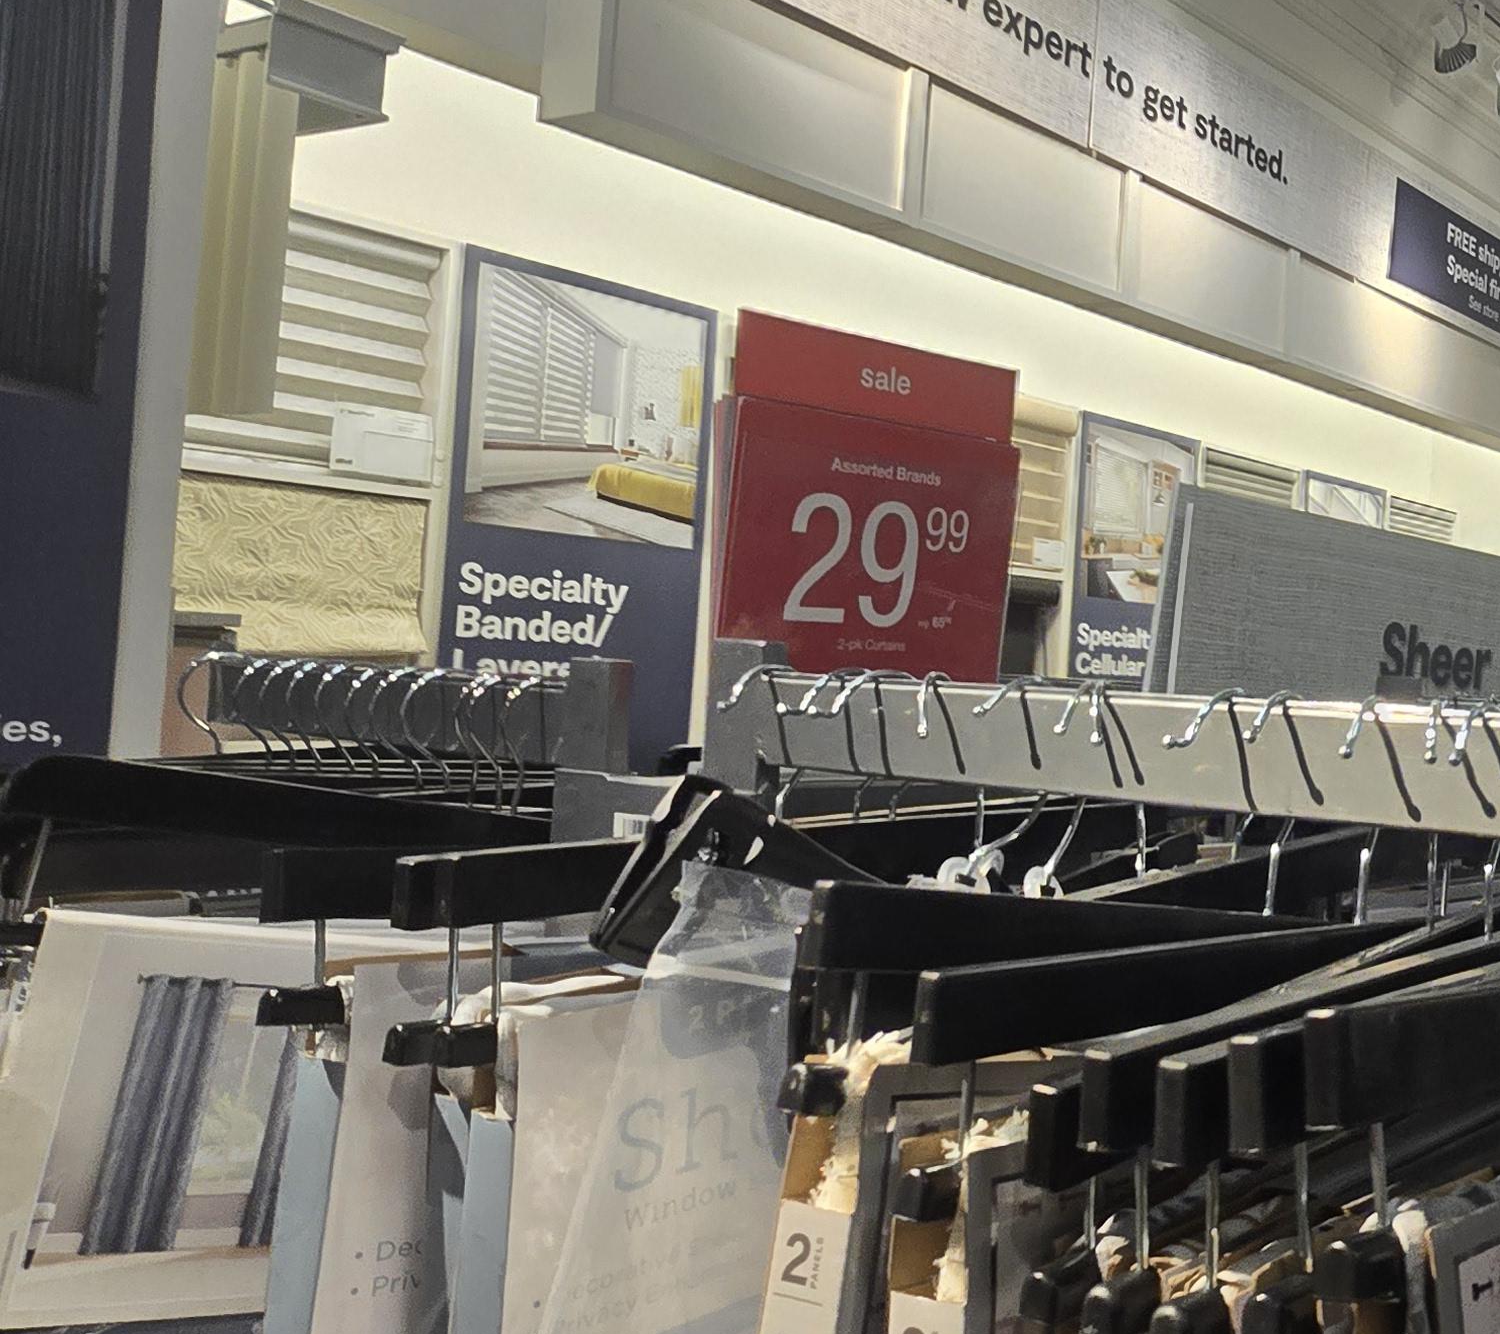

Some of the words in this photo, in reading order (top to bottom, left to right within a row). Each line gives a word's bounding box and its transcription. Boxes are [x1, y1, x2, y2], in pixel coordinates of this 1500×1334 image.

[1103, 55, 1134, 98] to
[1143, 85, 1188, 130] get
[1194, 112, 1289, 185] started.
[1446, 222, 1477, 257] FREE
[1446, 254, 1488, 293] Special
[860, 367, 912, 395] sale
[831, 457, 893, 480] Assorted
[896, 466, 942, 487] Brands
[783, 492, 919, 627] 29
[925, 506, 970, 553] 99
[458, 561, 630, 614] Specialty
[455, 604, 615, 648] Banded/
[1077, 622, 1151, 651] Specialt
[1075, 652, 1145, 677] Cellular
[1380, 621, 1492, 690] Sheer
[2, 720, 62, 747] es,
[781, 1232, 811, 1287] 2
[810, 1236, 825, 1290] PANELS
